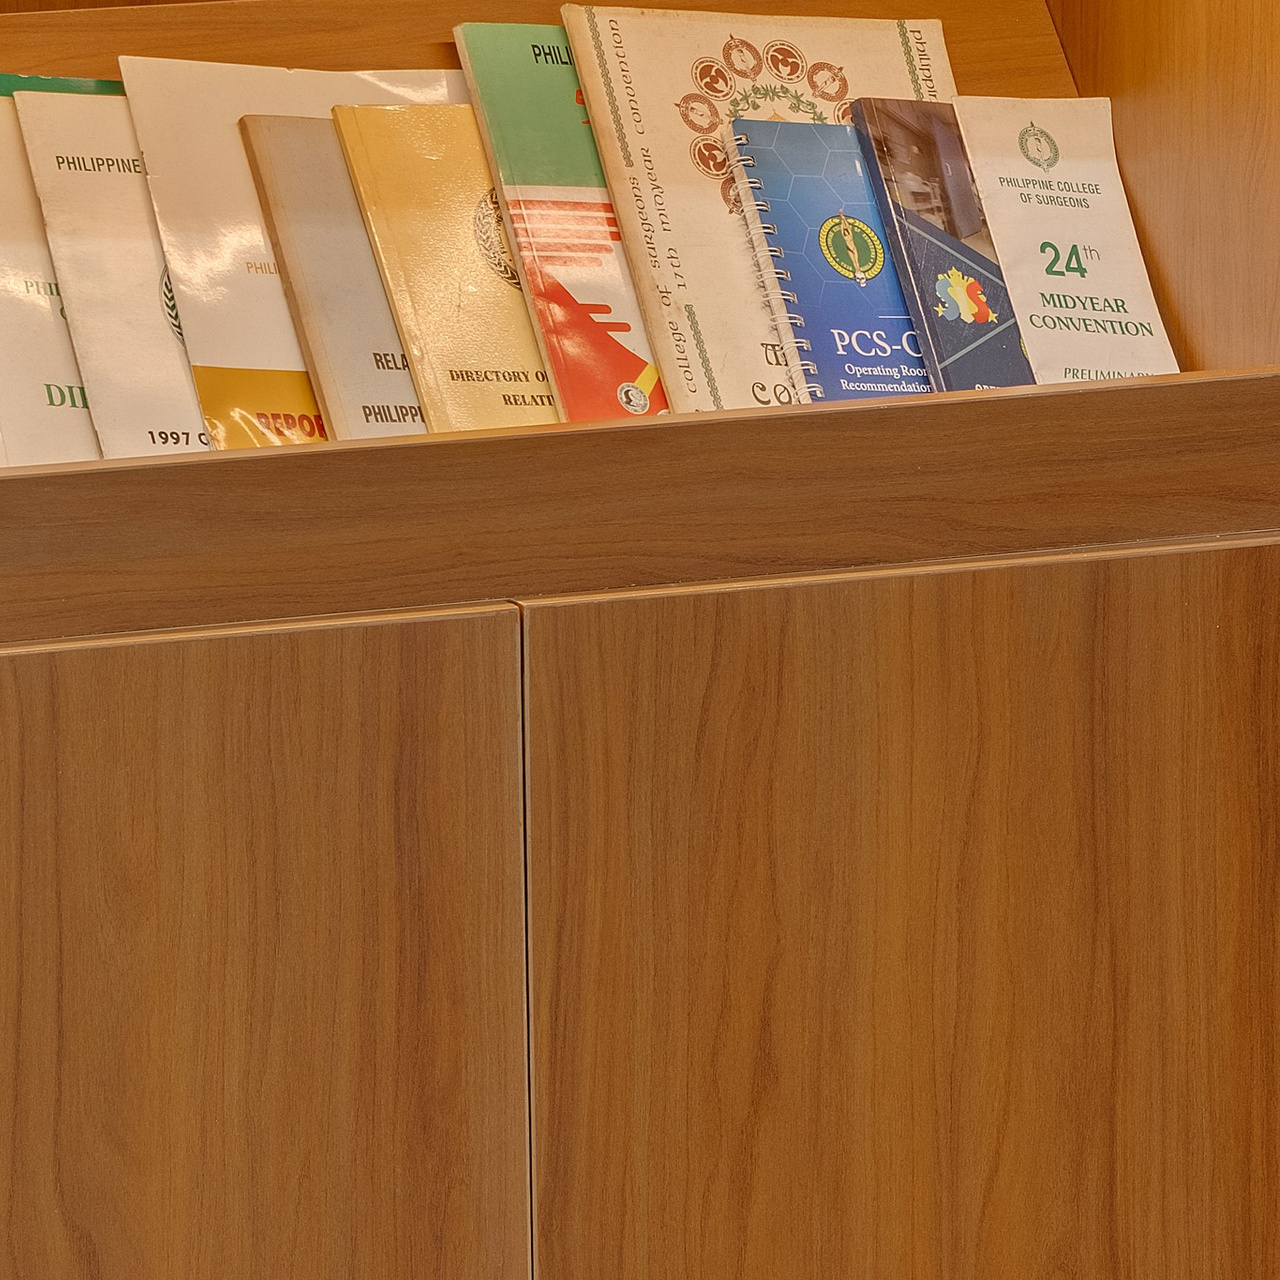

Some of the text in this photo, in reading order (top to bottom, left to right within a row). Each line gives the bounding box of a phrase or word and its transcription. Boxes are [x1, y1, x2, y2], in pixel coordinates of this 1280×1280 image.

[55, 155, 141, 174] PHILIPPINE
[999, 176, 1101, 194] PHILIPPINE COLLEGE
[1020, 192, 1090, 208] OF SURGEONS
[1039, 241, 1100, 278] 24th
[1039, 292, 1129, 314] MIDYEAR
[1029, 313, 1154, 337] CONVENTION
[448, 369, 530, 383] DIRECTORY
[844, 363, 900, 379] Operating
[148, 429, 190, 447] 1997
